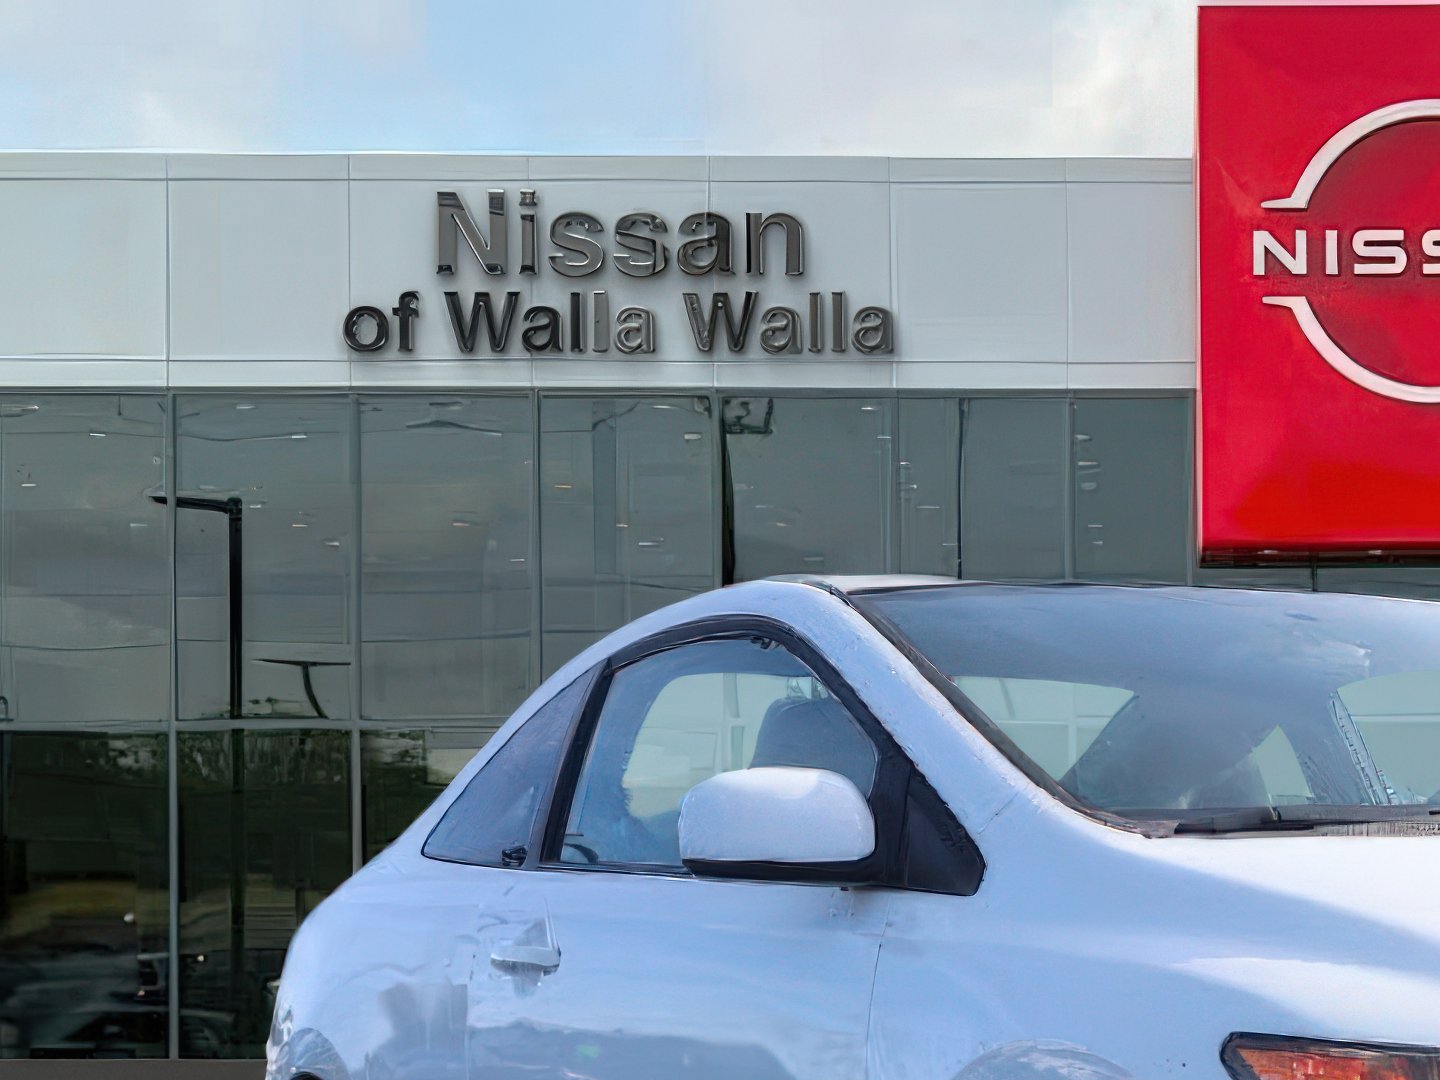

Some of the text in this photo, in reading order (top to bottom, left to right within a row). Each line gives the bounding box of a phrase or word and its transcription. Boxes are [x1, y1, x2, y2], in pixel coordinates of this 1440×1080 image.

[435, 188, 805, 277] Nissan
[341, 290, 895, 354] of Walla Walla
